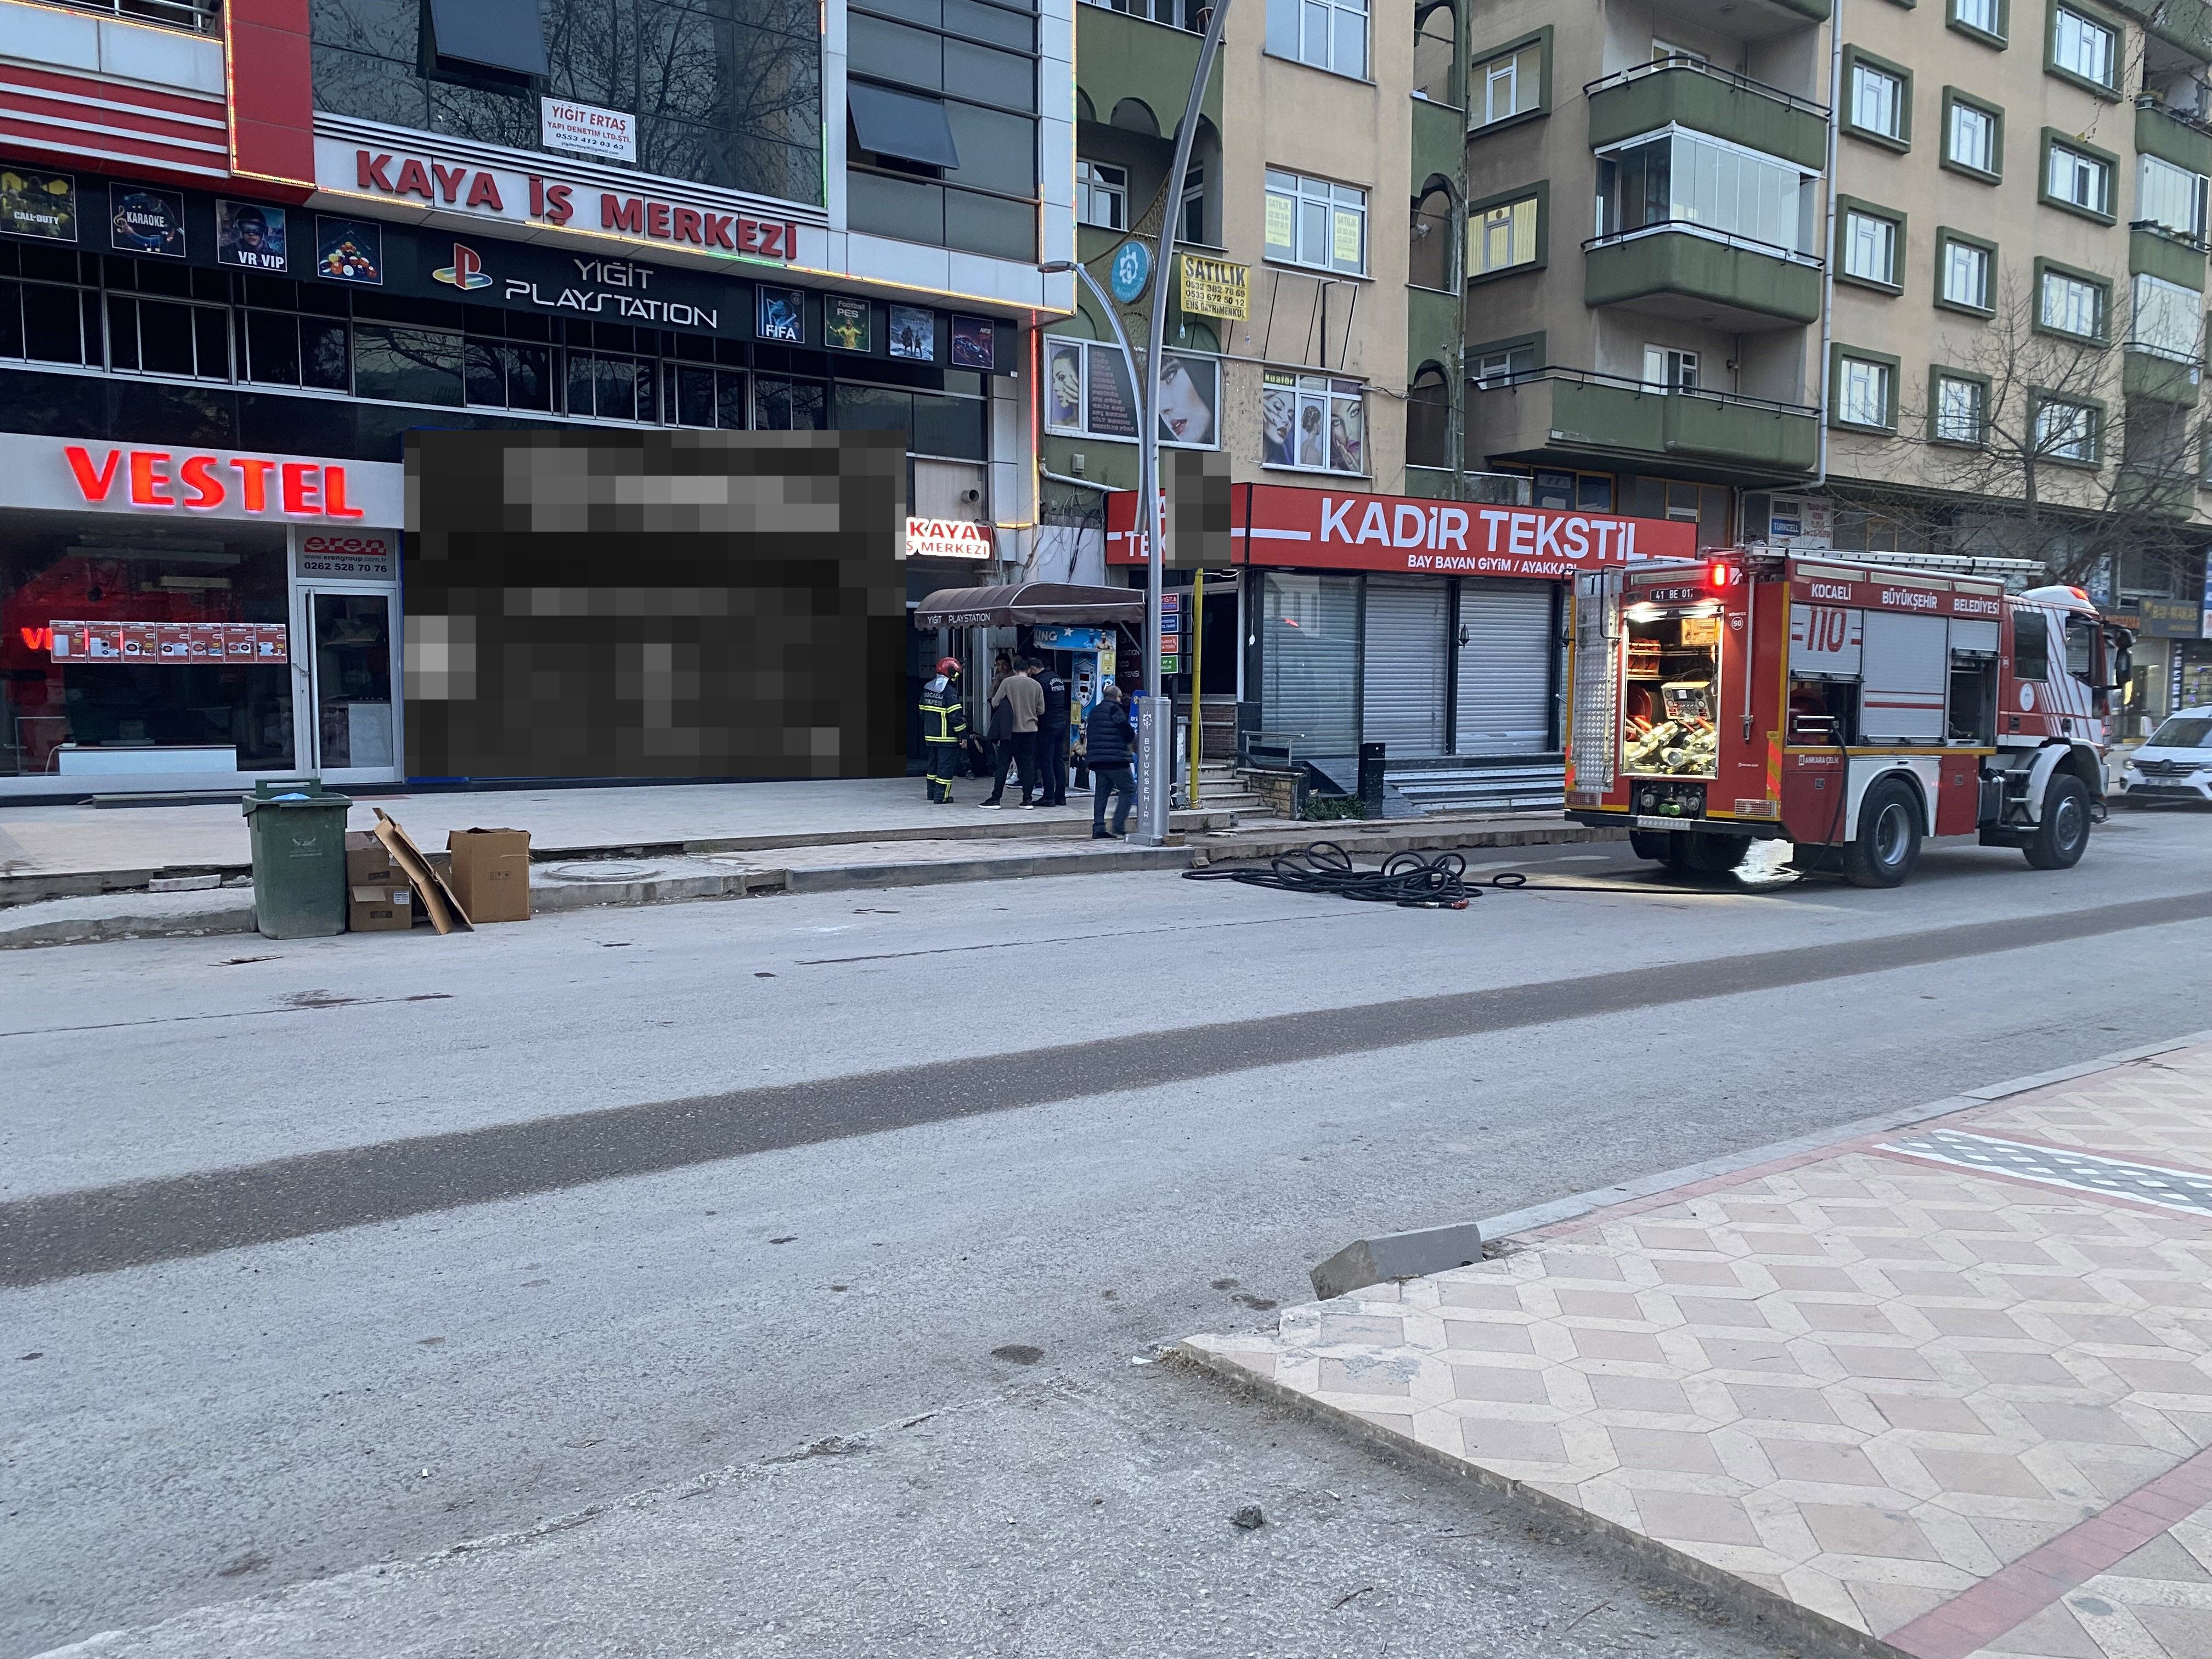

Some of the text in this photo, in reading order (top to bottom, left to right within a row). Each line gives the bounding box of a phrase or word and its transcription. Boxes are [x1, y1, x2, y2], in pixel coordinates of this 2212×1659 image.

[552, 104, 626, 134] YİĞİT ERTAŞ
[548, 121, 565, 130] YAPI
[567, 125, 600, 137] DENETİM
[556, 133, 578, 142] 0553
[356, 150, 797, 260] KAYA İŞ MERKEZİ
[126, 211, 165, 228] KARAOKE
[238, 251, 285, 269] VR VIP
[573, 258, 654, 290] YİĞİT
[1186, 257, 1245, 287] SATILIK
[1186, 280, 1204, 291] 0532
[1207, 284, 1222, 294] 382
[505, 278, 717, 329] PLAYSTATION
[838, 300, 865, 311] Football
[1186, 290, 1205, 300] 0533
[1207, 294, 1221, 302] 672
[1224, 296, 1233, 304] 50
[837, 308, 859, 318] PES
[765, 324, 797, 341] FIFA
[64, 446, 364, 517] VESTEL
[910, 521, 978, 540] KAYA
[1321, 497, 1649, 561] KADİR TEKSTİL
[1773, 522, 1799, 533] TURKCELL
[305, 536, 386, 554] eren
[921, 541, 986, 556] MERKEZİ
[304, 554, 387, 563] www.erengroup.com.tr
[1408, 555, 1433, 568] BAY
[1435, 556, 1476, 569] BAYAN
[1478, 557, 1511, 572] GİYİM
[304, 562, 331, 571] 0262
[335, 563, 354, 571] 528
[374, 565, 387, 573] 76
[1656, 590, 1664, 600] 41
[1669, 589, 1678, 599] BE
[1811, 583, 2000, 615] KOCAELİ BÜYÜKŞEHİR BELEDİYESİ
[948, 612, 991, 623] PLAYSTATION
[1807, 605, 1847, 653] 110
